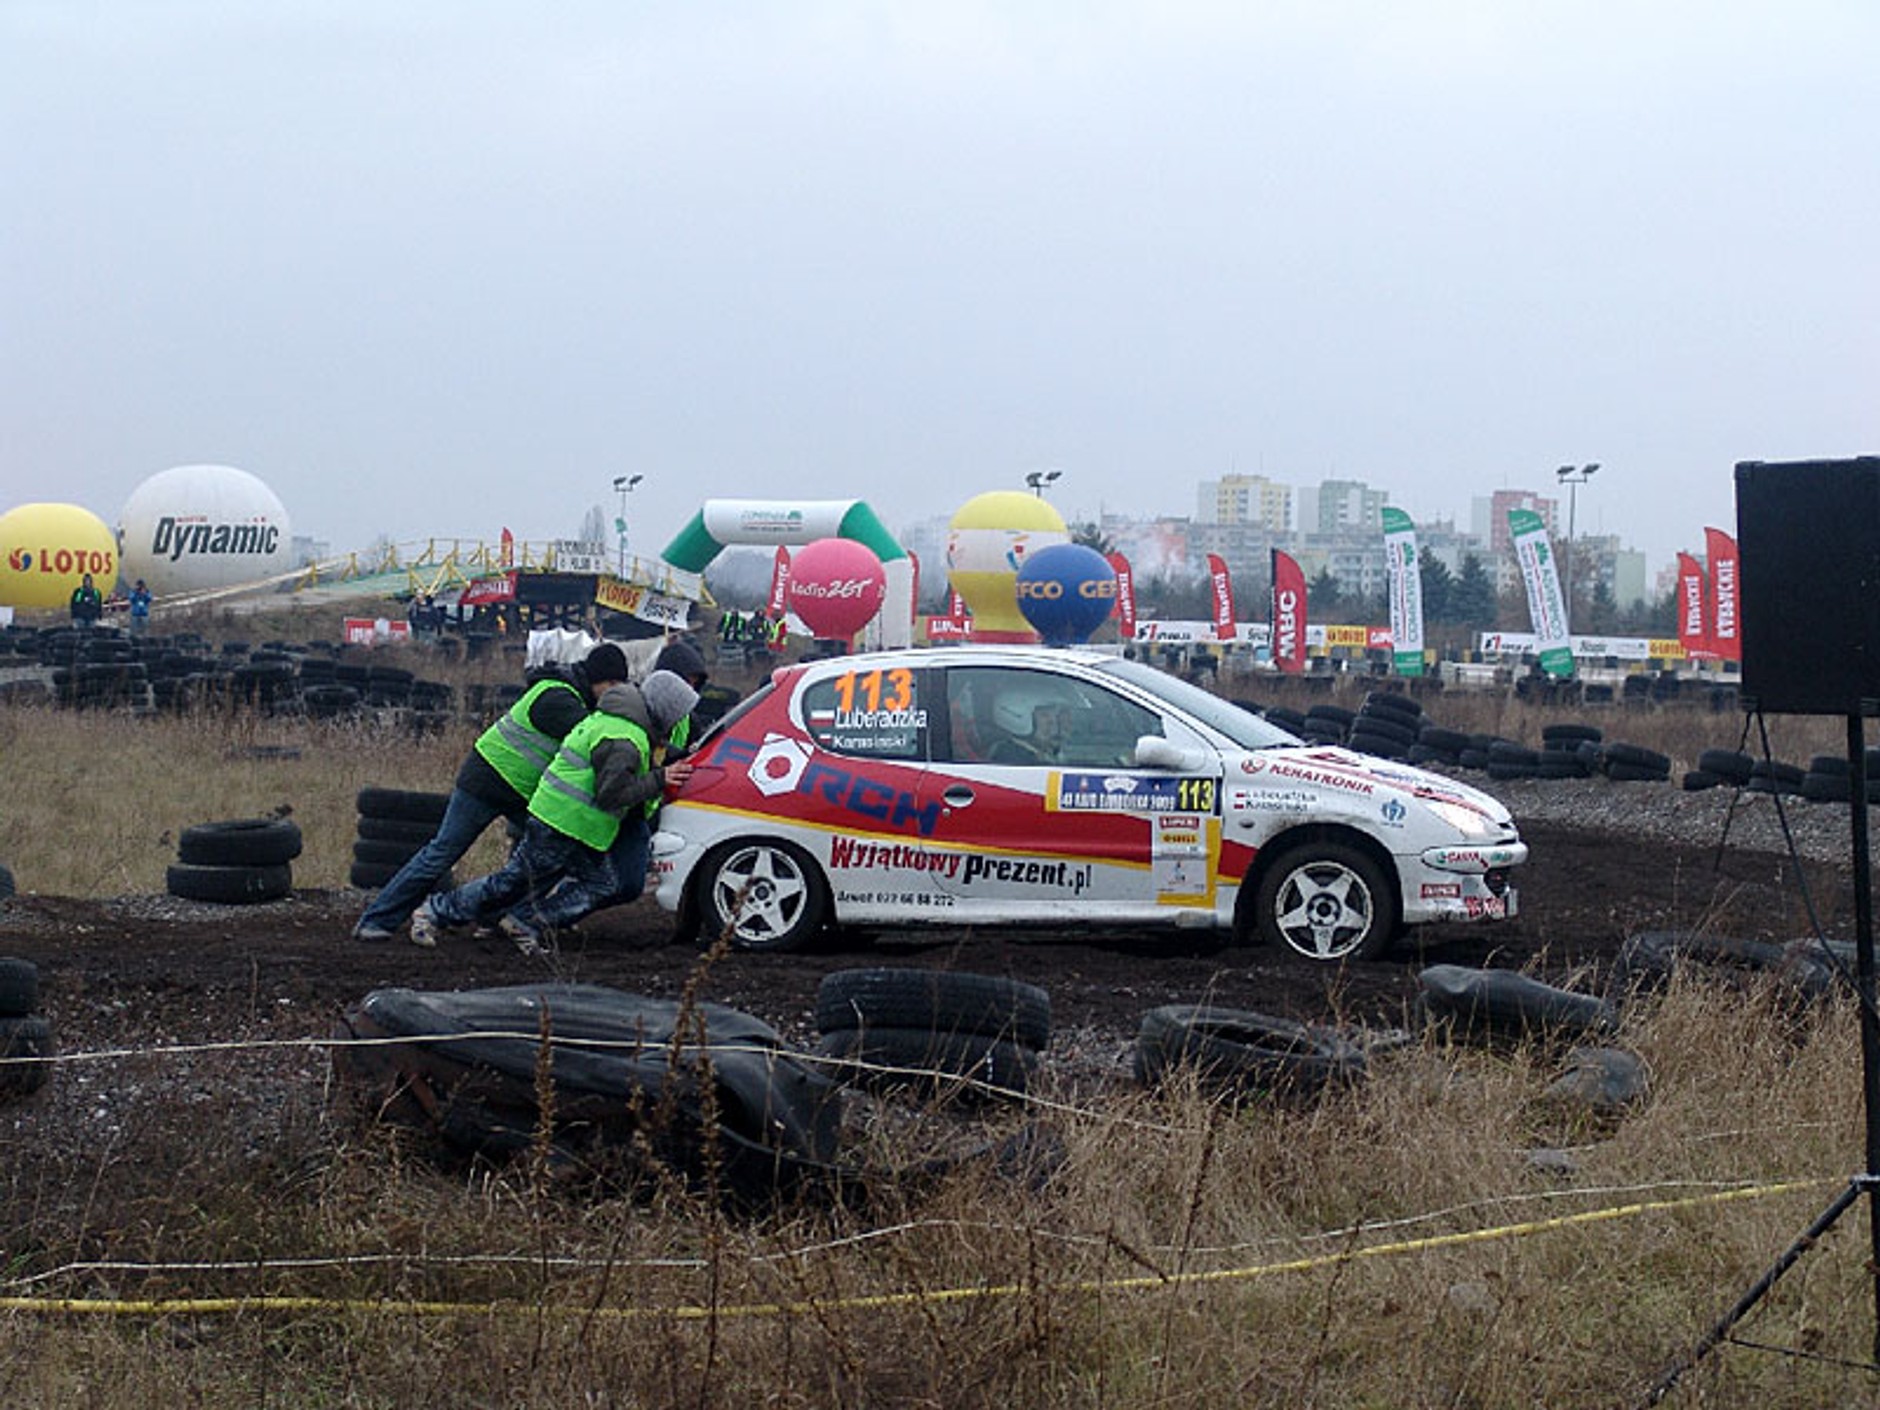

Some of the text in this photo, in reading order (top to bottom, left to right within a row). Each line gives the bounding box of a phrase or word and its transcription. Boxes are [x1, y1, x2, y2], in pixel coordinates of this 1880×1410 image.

[152, 517, 279, 561] Dynamic
[40, 549, 112, 574] LOTOS
[827, 578, 873, 598] ZET
[834, 668, 913, 712] 113
[1179, 779, 1214, 811] 113
